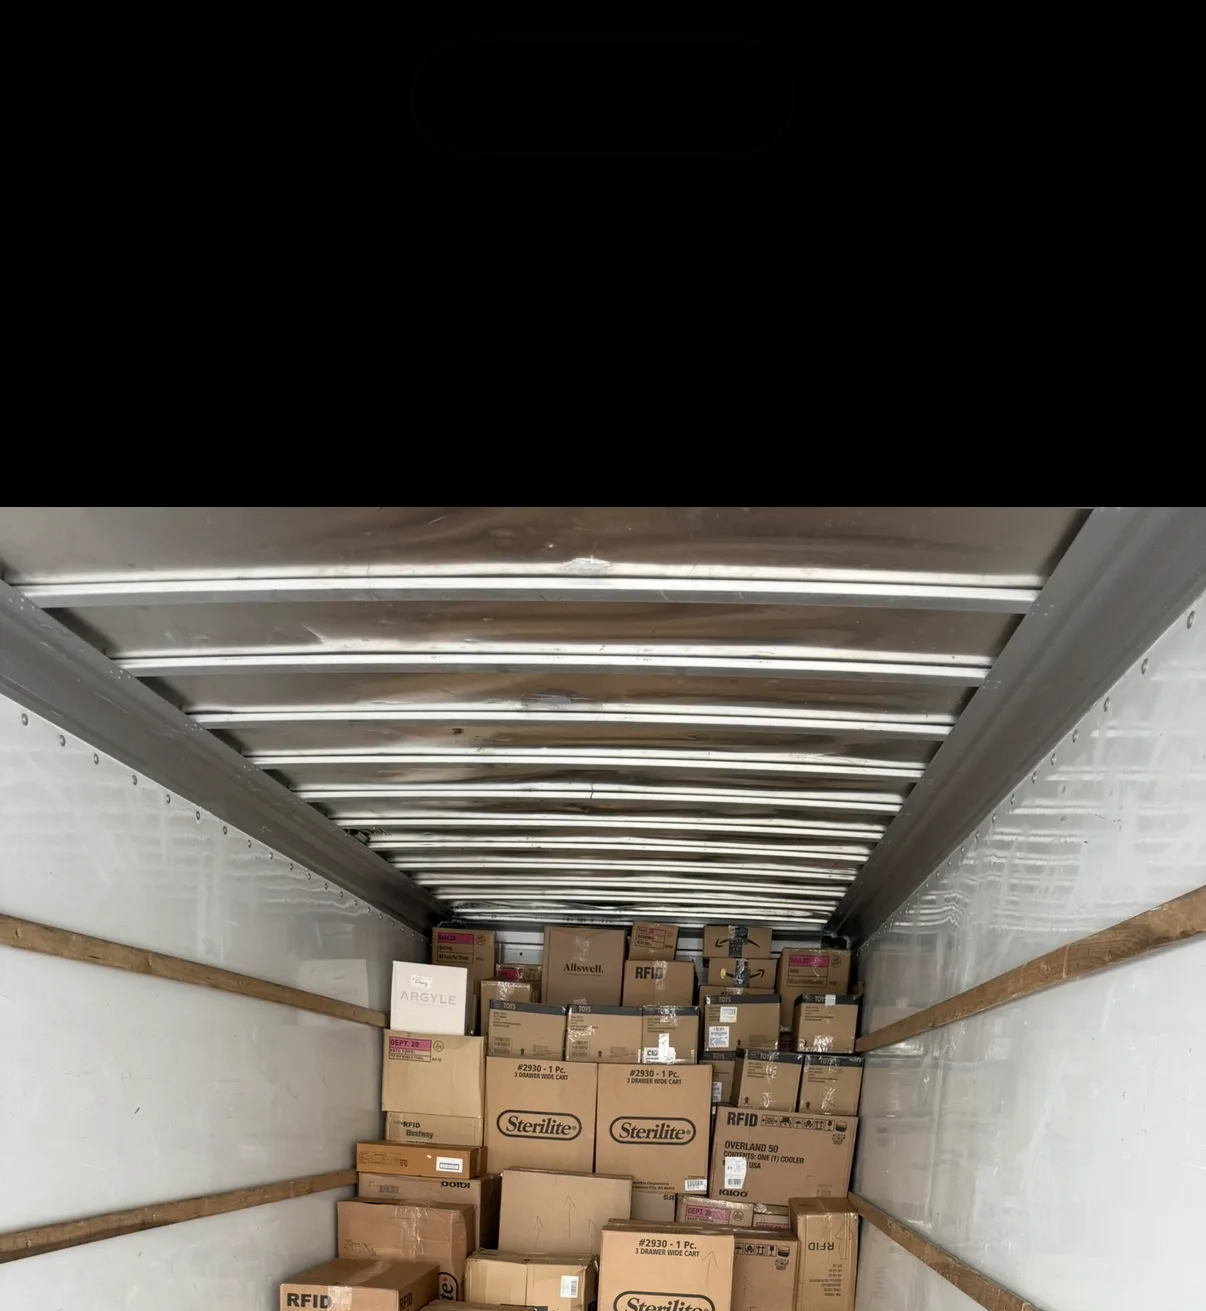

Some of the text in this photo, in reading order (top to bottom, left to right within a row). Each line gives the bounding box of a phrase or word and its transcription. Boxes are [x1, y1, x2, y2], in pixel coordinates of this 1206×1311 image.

[635, 966, 664, 980] RFID
[400, 990, 457, 1006] ARGYLE
[578, 1005, 592, 1013] TOYS
[390, 1038, 420, 1048] DEPT. 20
[517, 1064, 541, 1072] #2930
[548, 1065, 553, 1073] 1
[555, 1066, 566, 1074] Pc.
[629, 1069, 654, 1078] #2930
[661, 1070, 665, 1078] 1
[668, 1070, 680, 1079] Pc.
[727, 1111, 758, 1127] RFID
[406, 1129, 434, 1139] Bestway
[725, 1140, 779, 1153] OVERLAND 50
[723, 1151, 756, 1160] CONTENTS:
[770, 1155, 780, 1163] (1)
[780, 1156, 804, 1164] COOLER
[749, 1161, 761, 1169] USA
[687, 1207, 704, 1216] DEPT.
[638, 1239, 667, 1248] #2930
[684, 1241, 697, 1249] Pc.
[808, 1242, 834, 1251] RFID
[640, 1248, 666, 1256] DRAWER
[286, 1293, 332, 1309] RFID
